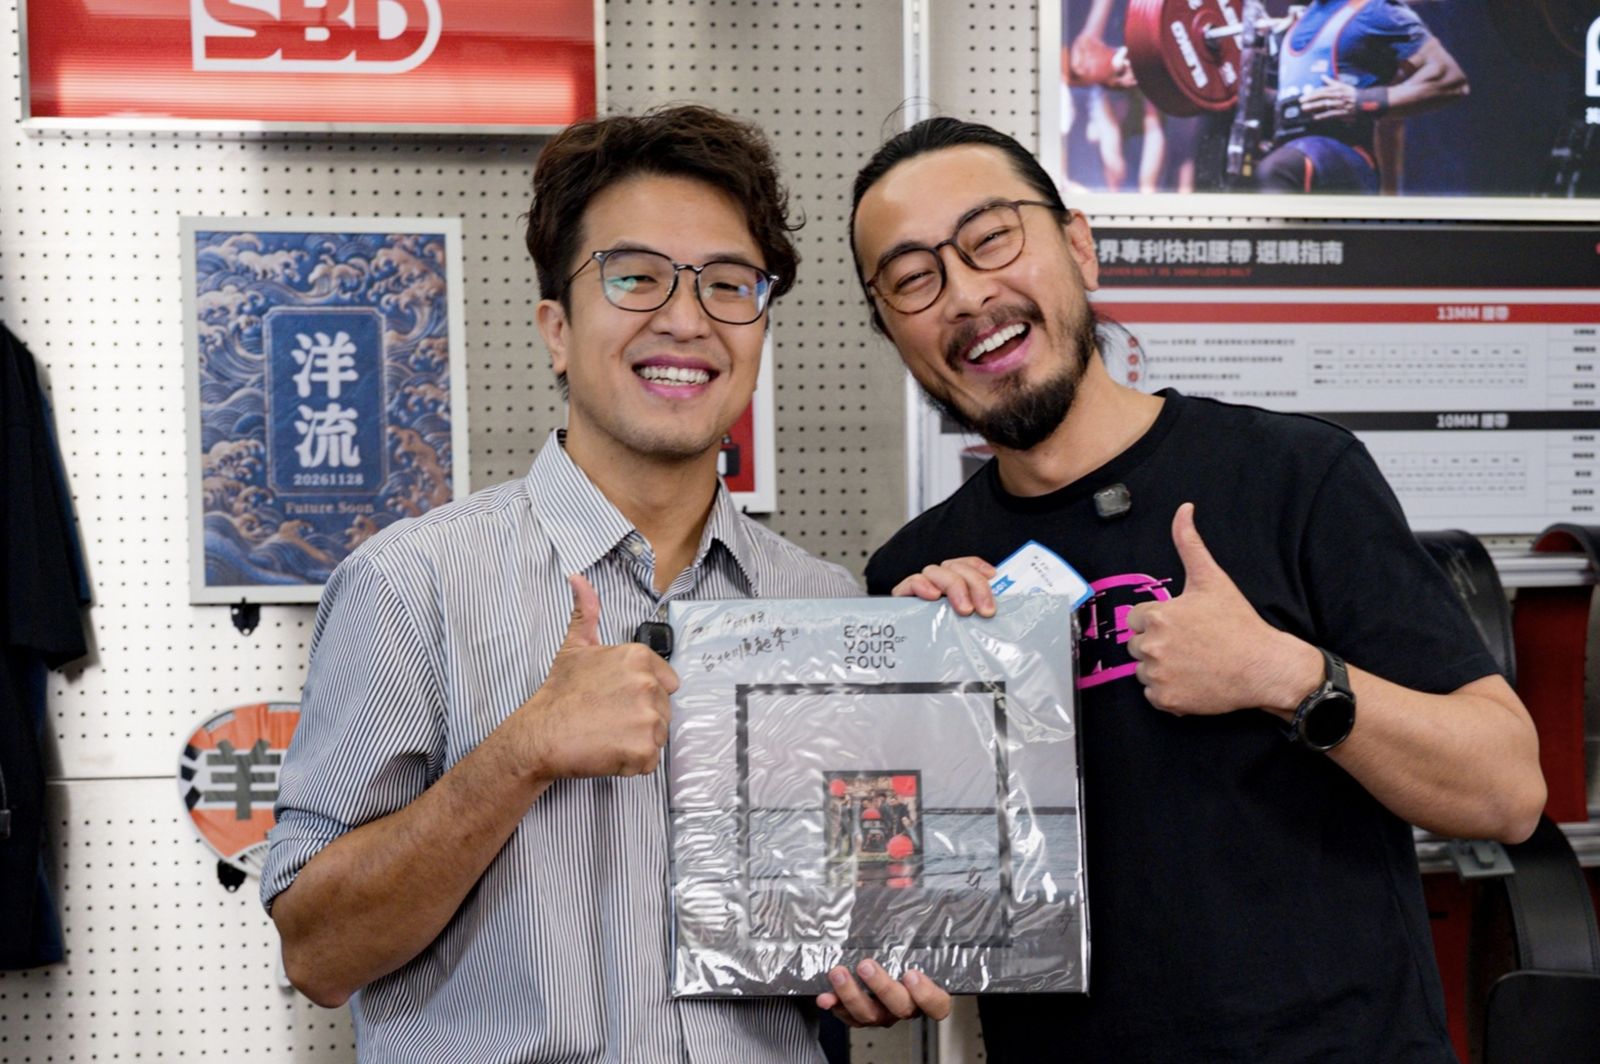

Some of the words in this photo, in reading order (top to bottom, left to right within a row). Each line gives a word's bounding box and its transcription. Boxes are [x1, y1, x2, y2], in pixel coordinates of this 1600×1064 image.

[202, 0, 430, 62] SBD
[1095, 239, 1252, 264] 界專利快扣腰帶
[1256, 240, 1344, 265] 選購指南
[1437, 305, 1479, 320] 13MM
[291, 331, 361, 468] 洋流
[1436, 413, 1479, 428] 10MM
[293, 473, 364, 486] 20261128
[285, 501, 334, 515] Future
[338, 501, 374, 514] Soon
[843, 624, 896, 639] ECHO
[843, 640, 896, 654] YOUR
[843, 655, 896, 669] SOUL
